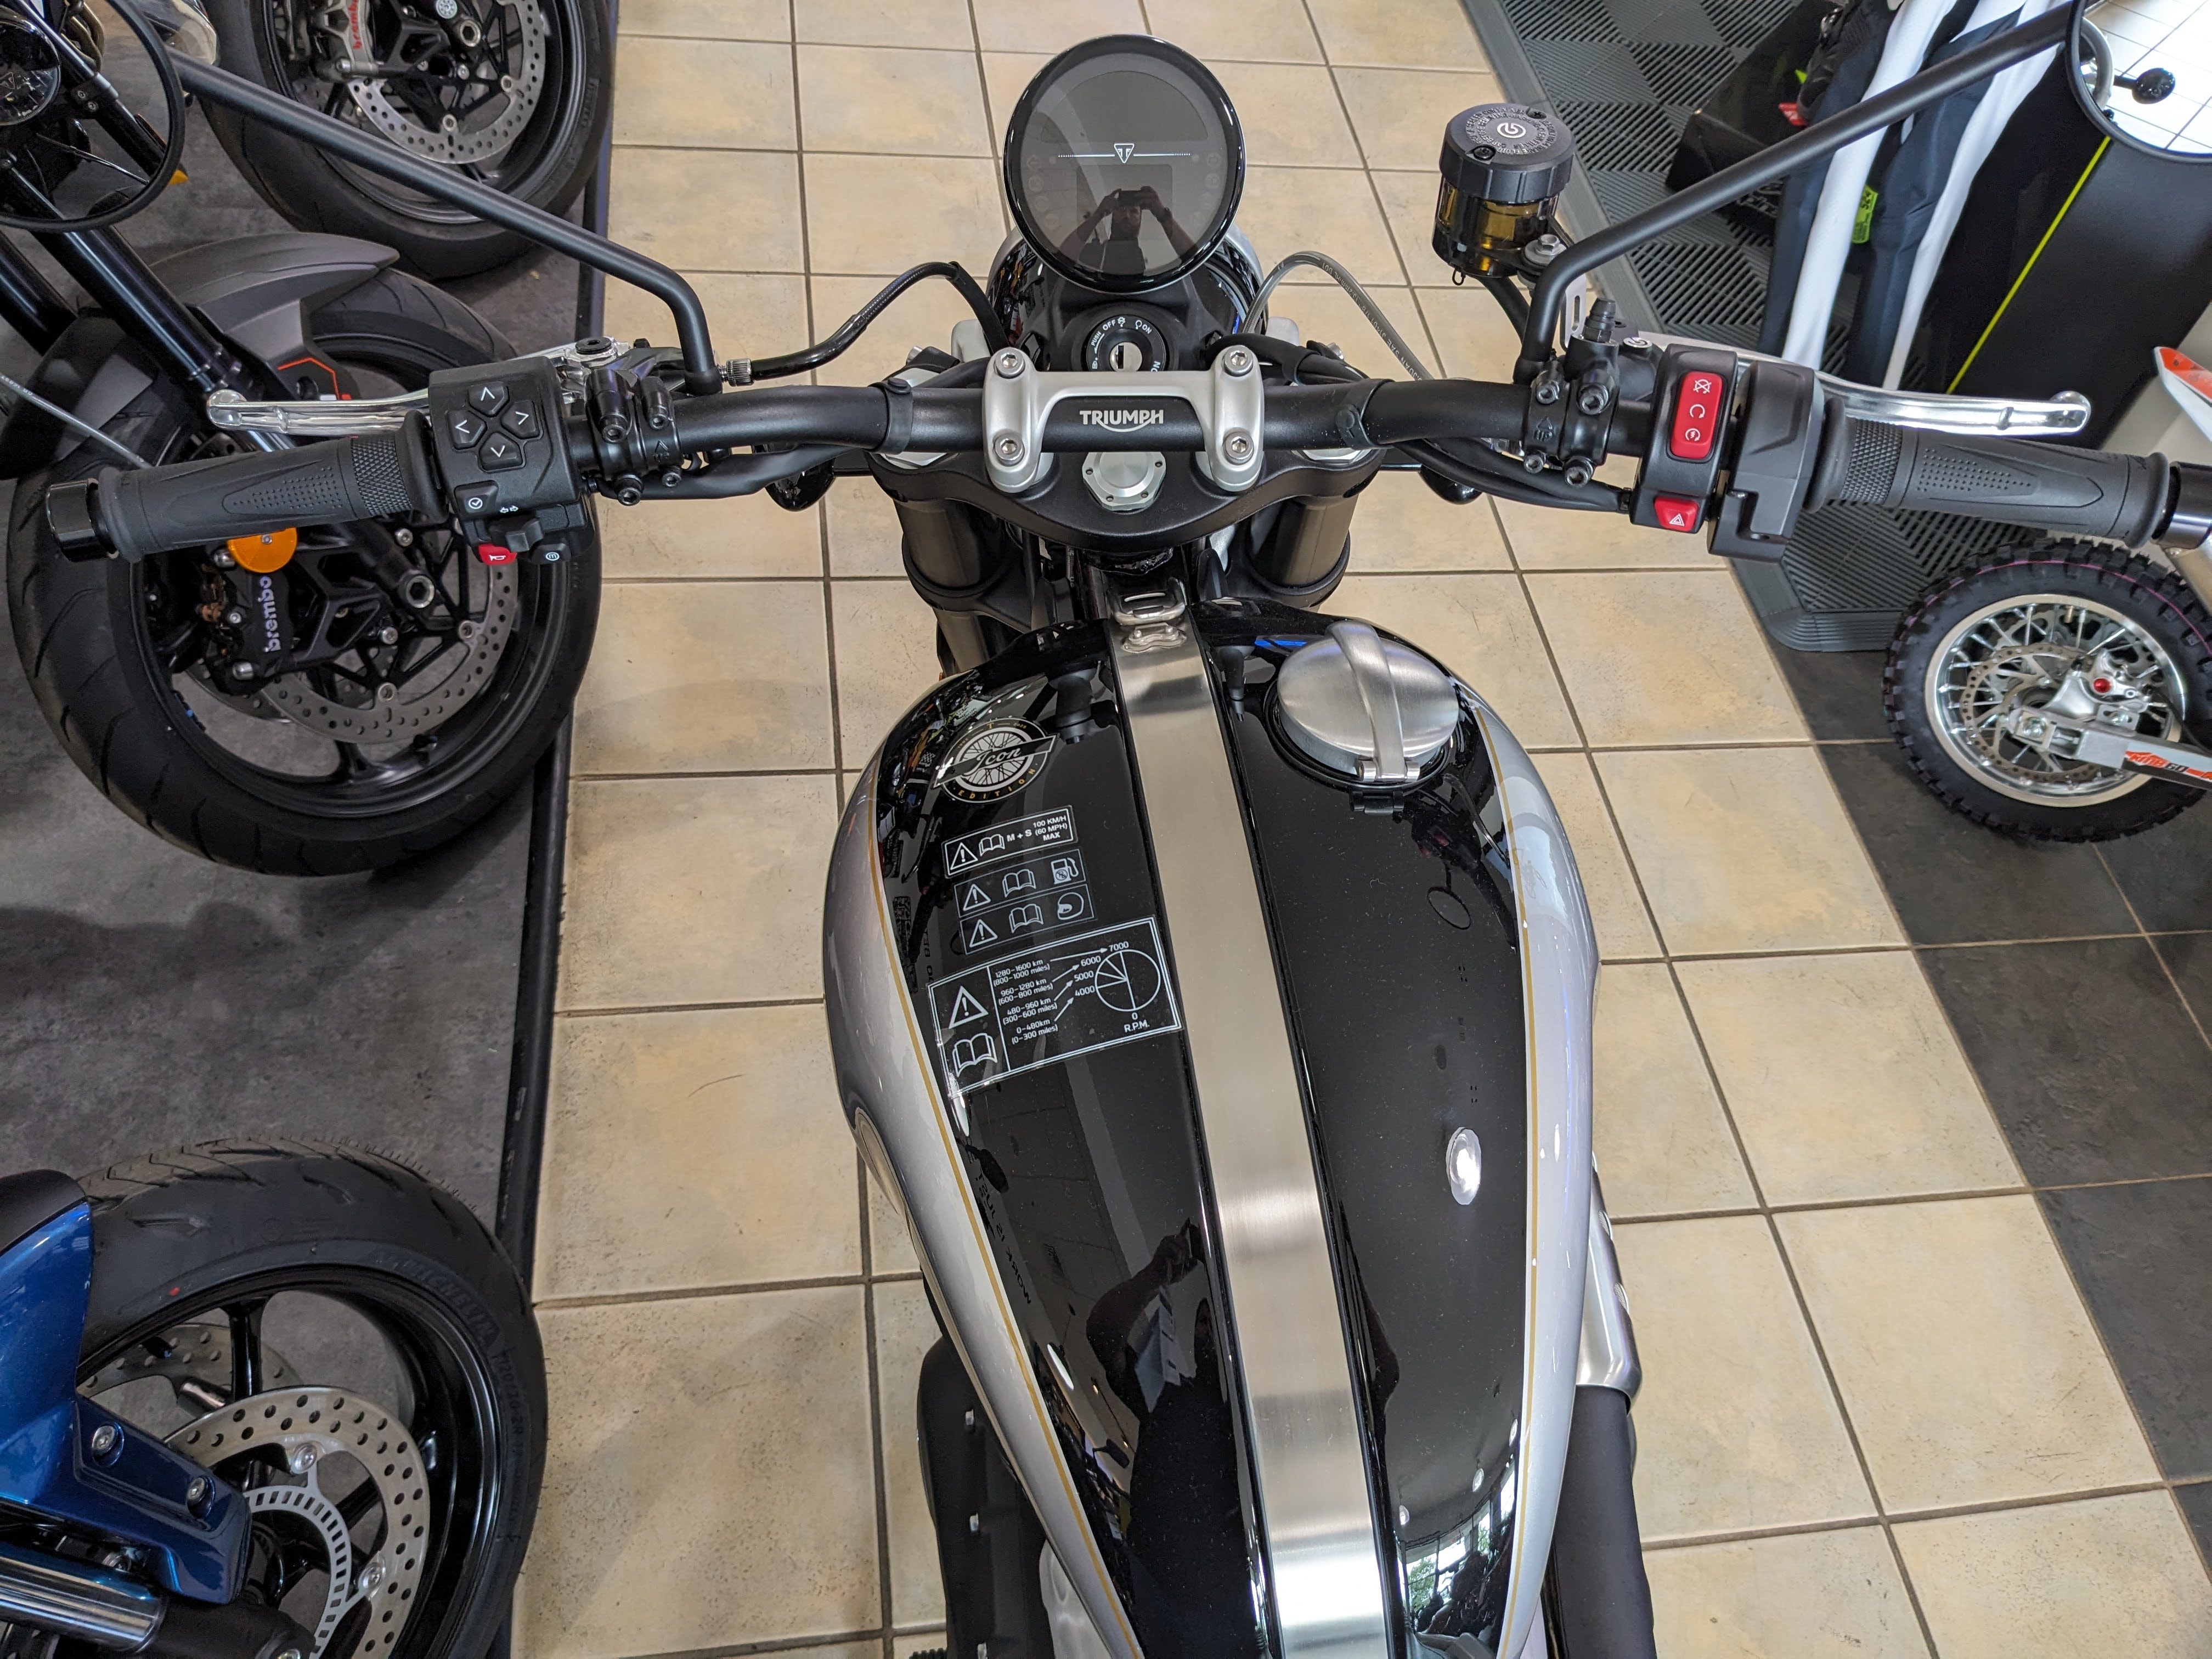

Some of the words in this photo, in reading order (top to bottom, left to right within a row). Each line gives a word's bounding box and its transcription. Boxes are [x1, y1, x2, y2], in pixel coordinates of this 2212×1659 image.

[348, 0, 363, 49] bremb
[1103, 319, 1116, 331] OFF
[1142, 325, 1152, 334] ON
[1091, 331, 1102, 346] PUSH
[1080, 410, 1164, 432] TRIUMPH
[258, 575, 281, 652] brembo
[970, 747, 1022, 770] Icon
[957, 768, 1036, 799] EDITION
[1032, 821, 1046, 829] 100
[1047, 815, 1066, 825] KM/H
[1007, 833, 1015, 842] M
[1025, 829, 1032, 838] S
[1035, 827, 1046, 837] (60
[1047, 822, 1068, 833] MPH)
[1043, 831, 1061, 841] MAX
[1109, 941, 1129, 951] 7000
[1081, 956, 1101, 966] 6000
[1031, 963, 1050, 975] miles)
[1074, 970, 1093, 981] 5000
[1034, 983, 1053, 994] miles)
[1075, 986, 1094, 996] 4000
[1038, 1002, 1058, 1014] miles)
[1039, 1024, 1058, 1036] miles)
[1124, 1021, 1150, 1032] R.P.M.
